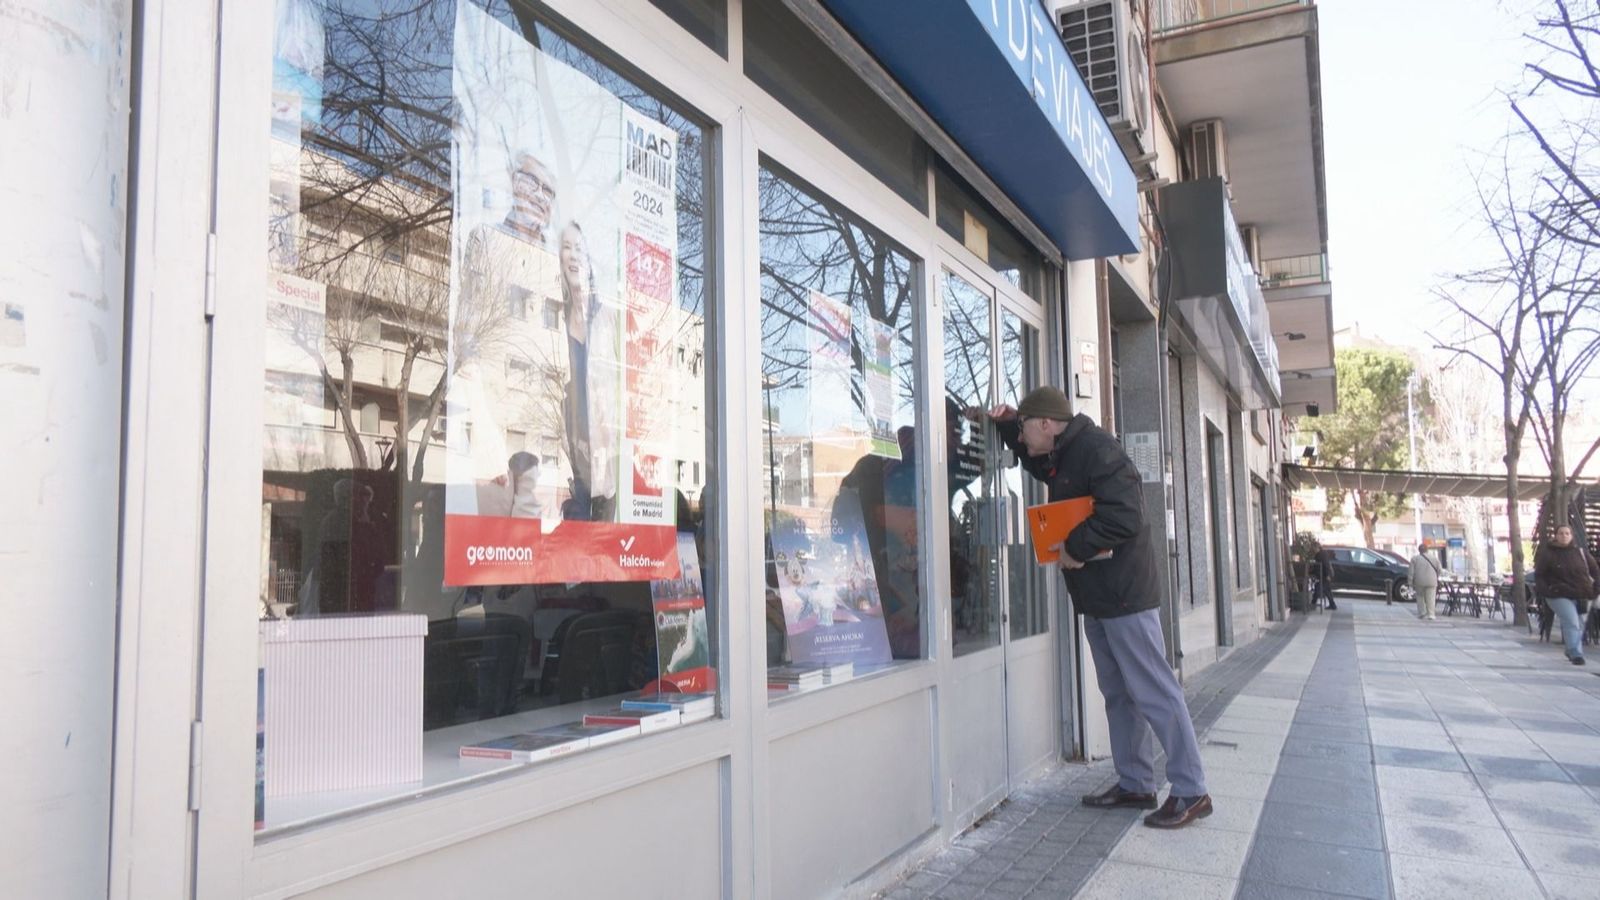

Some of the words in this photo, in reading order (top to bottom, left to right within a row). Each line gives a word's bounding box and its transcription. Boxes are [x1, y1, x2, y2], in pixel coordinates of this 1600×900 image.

[1048, 42, 1113, 198] VIAJES
[626, 119, 672, 160] MAD
[633, 189, 664, 218] 2024
[276, 279, 320, 302] Special
[632, 499, 663, 509] Comunidad
[632, 508, 641, 517] de
[642, 509, 663, 518] Madrid
[466, 545, 533, 566] geomoon
[619, 553, 650, 568] Halcón
